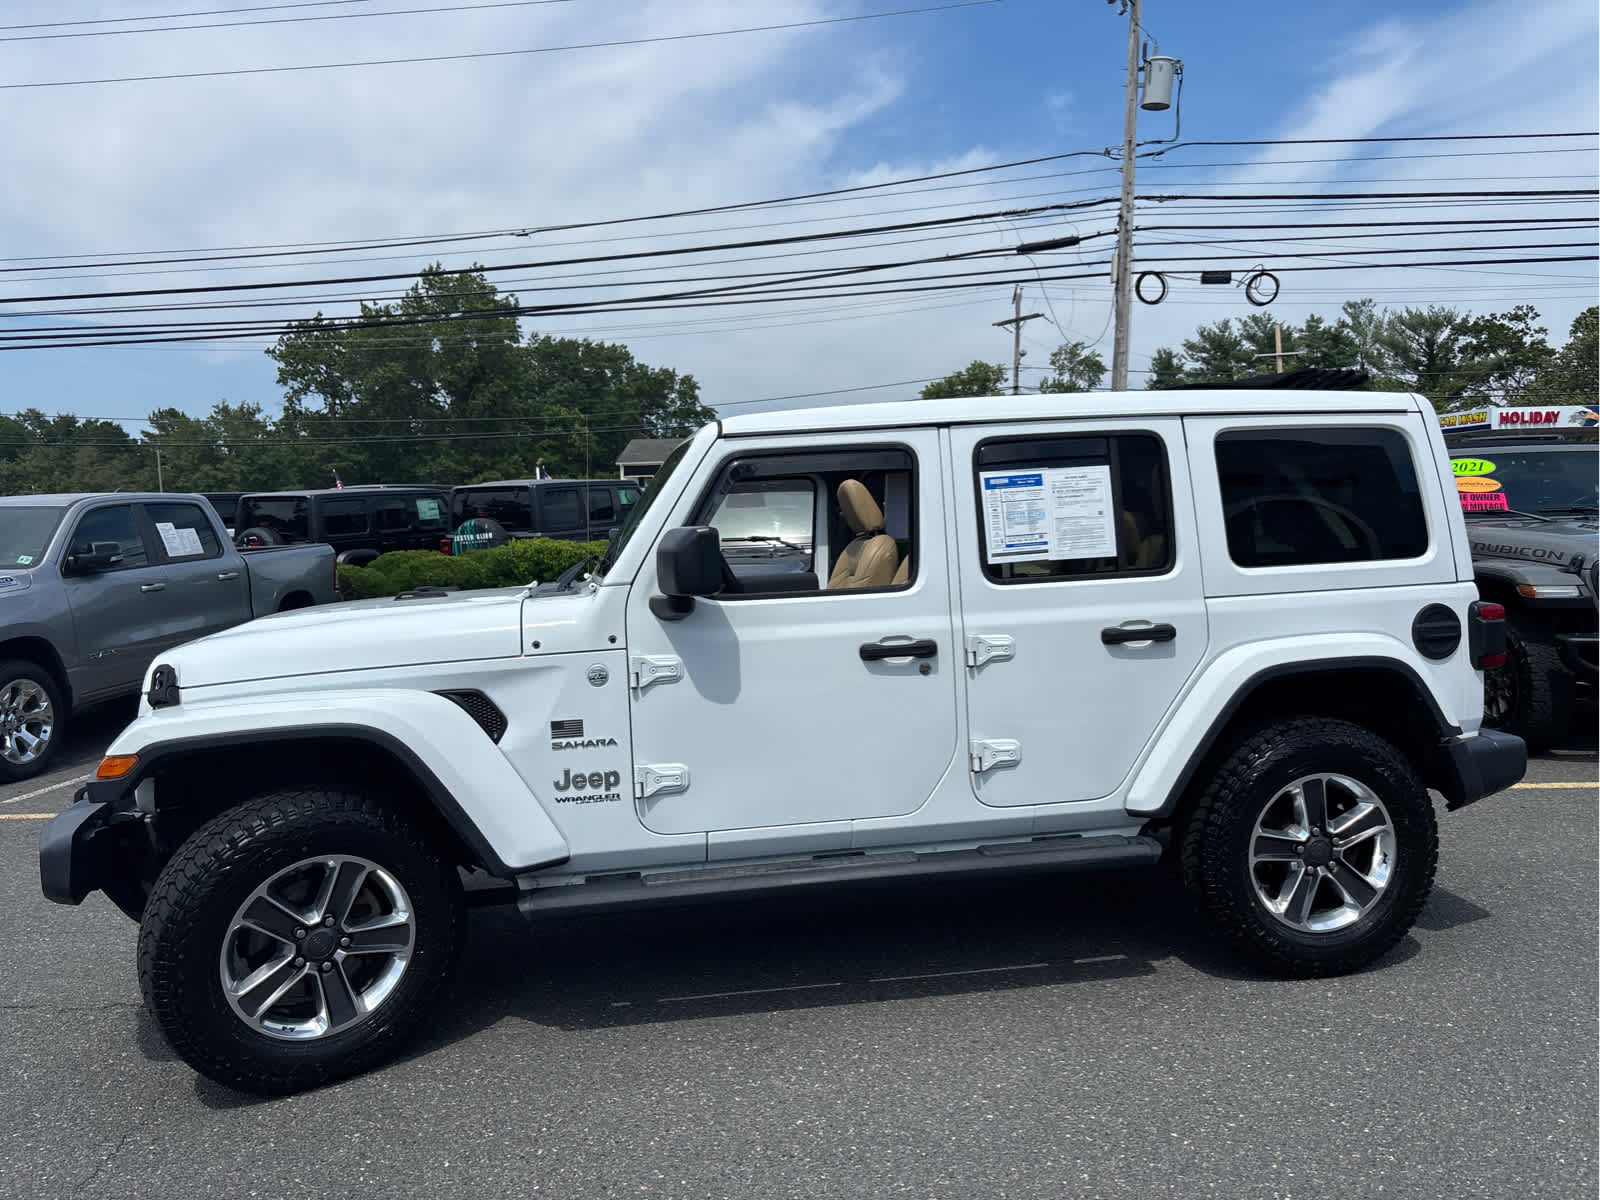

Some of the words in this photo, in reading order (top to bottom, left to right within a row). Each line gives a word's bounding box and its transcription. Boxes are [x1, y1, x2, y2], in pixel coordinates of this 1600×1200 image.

[1458, 411, 1487, 424] WASH
[1499, 411, 1560, 424] HOLIDAY
[1452, 462, 1484, 472] 2021
[1470, 493, 1501, 501] OWNER
[1472, 542, 1564, 560] RUBICON
[551, 738, 618, 750] SAHARA
[553, 768, 621, 792] Jeep
[555, 793, 621, 803] WRANGLER
